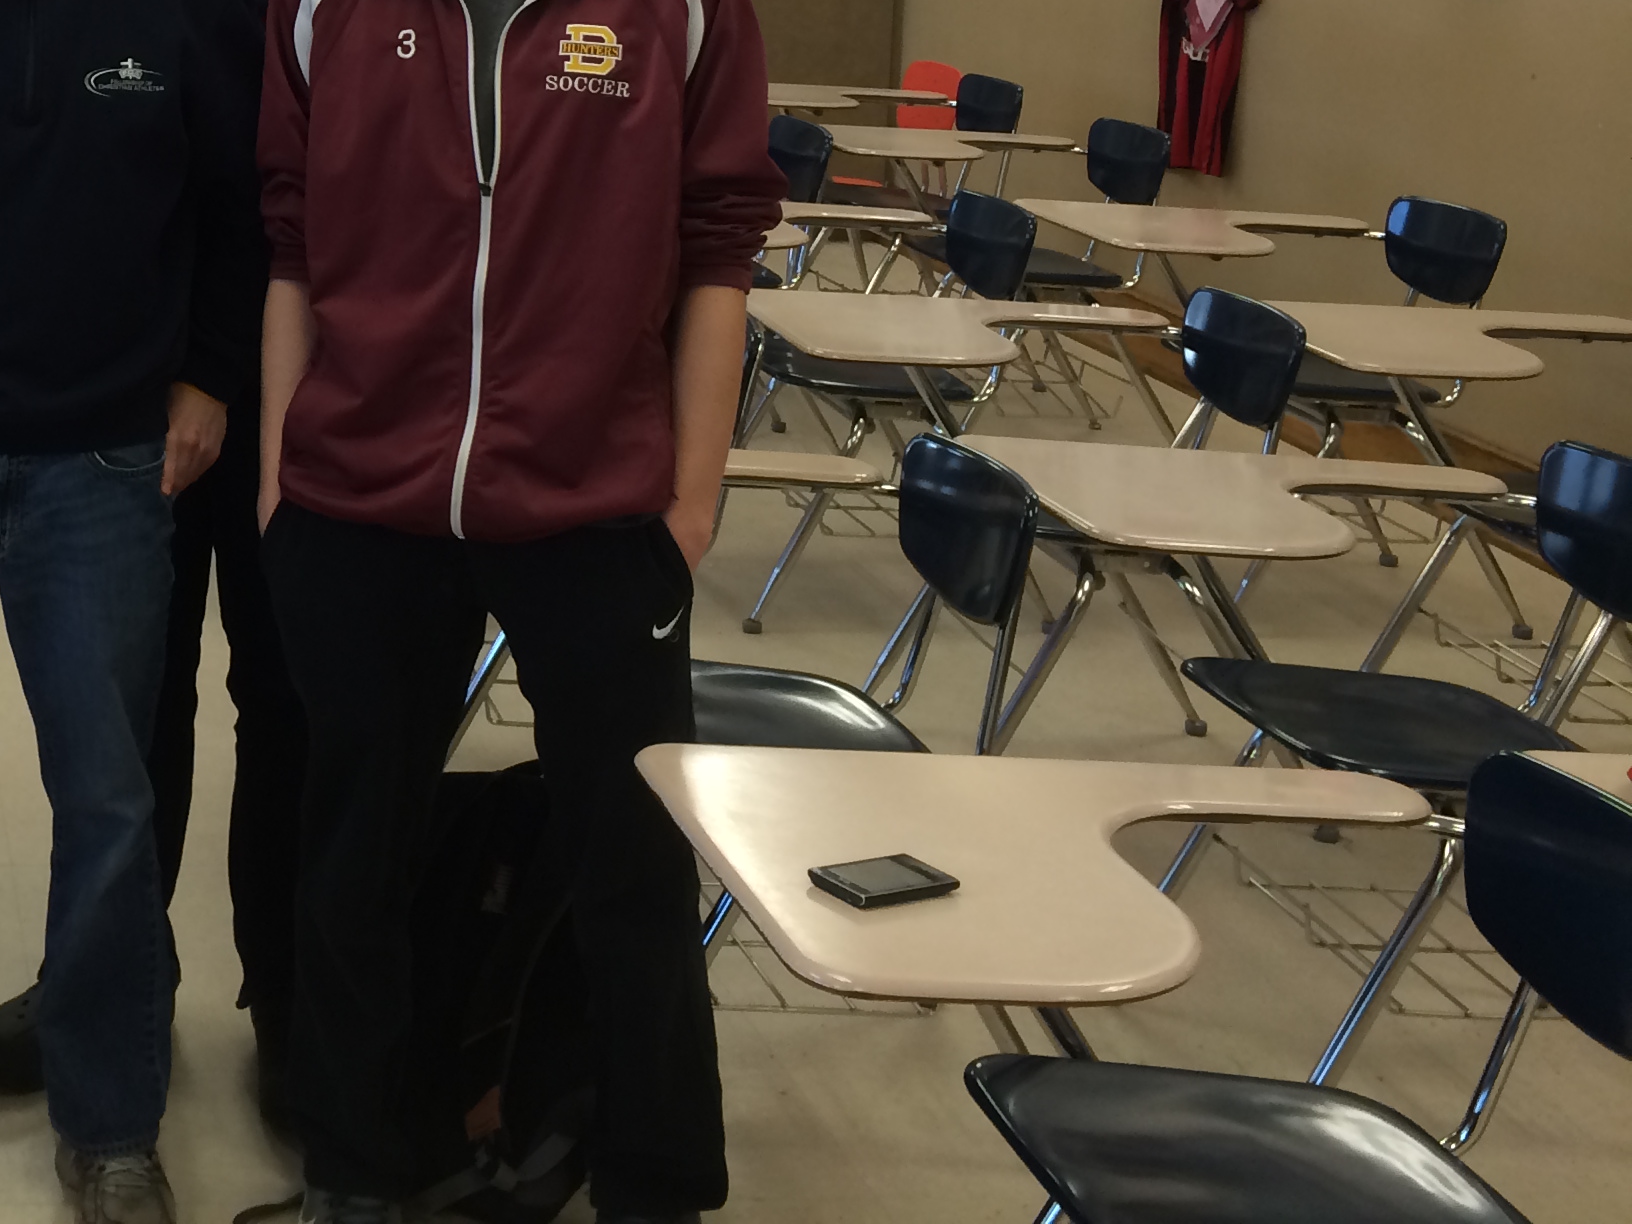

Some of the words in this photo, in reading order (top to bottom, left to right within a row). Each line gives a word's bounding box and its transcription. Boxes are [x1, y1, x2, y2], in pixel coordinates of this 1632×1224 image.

[396, 29, 416, 59] 3
[561, 41, 620, 58] HUNTERS
[563, 23, 617, 75] D
[545, 75, 631, 98] SOCCER
